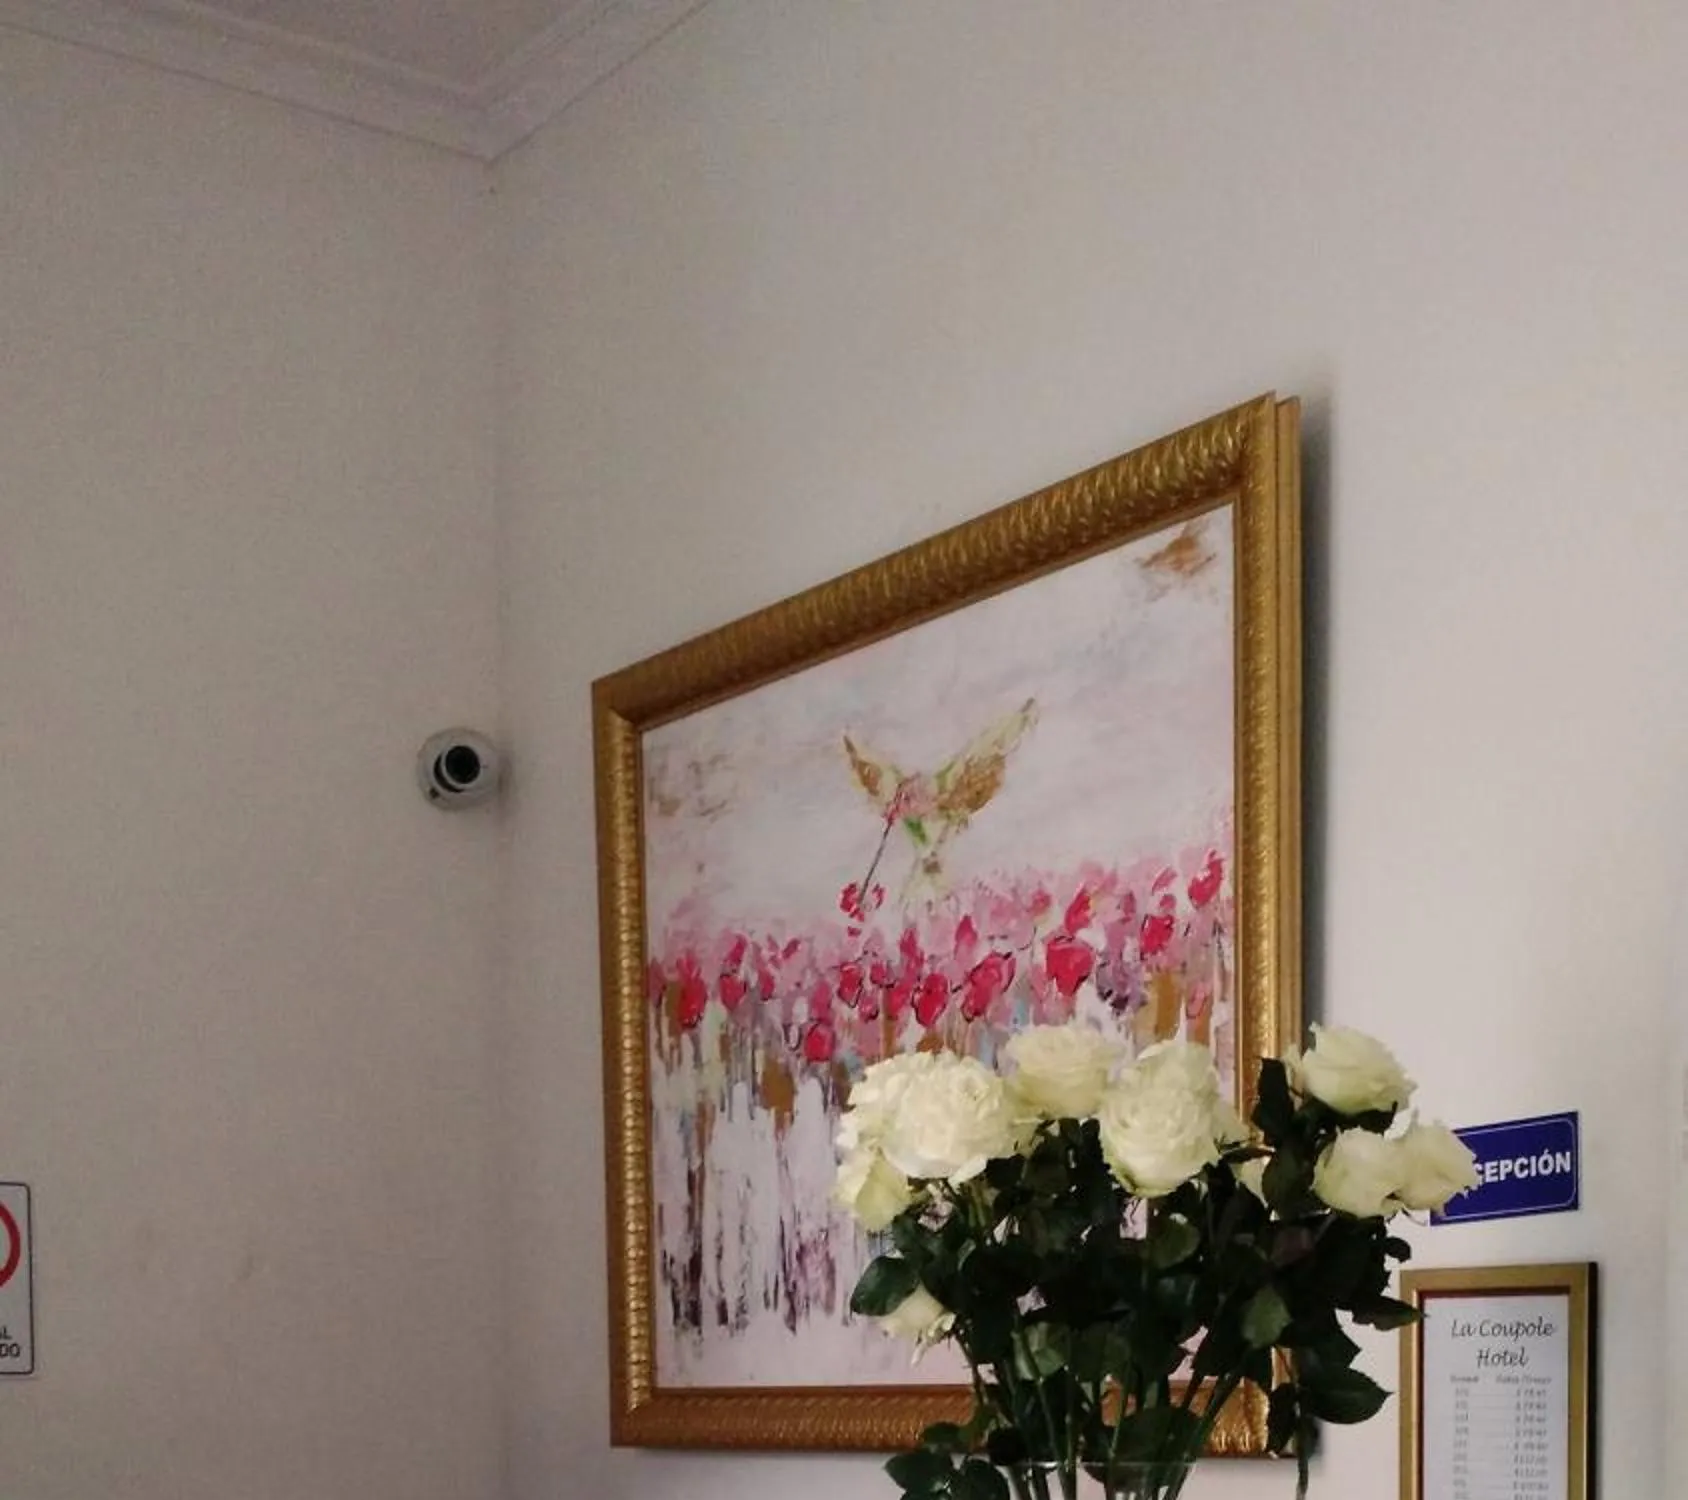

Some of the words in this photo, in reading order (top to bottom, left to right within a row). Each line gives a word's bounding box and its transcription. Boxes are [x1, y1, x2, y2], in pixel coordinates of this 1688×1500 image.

[1451, 1318, 1477, 1337] La
[1479, 1315, 1556, 1341] Coupole
[1476, 1346, 1529, 1369] Hotel
